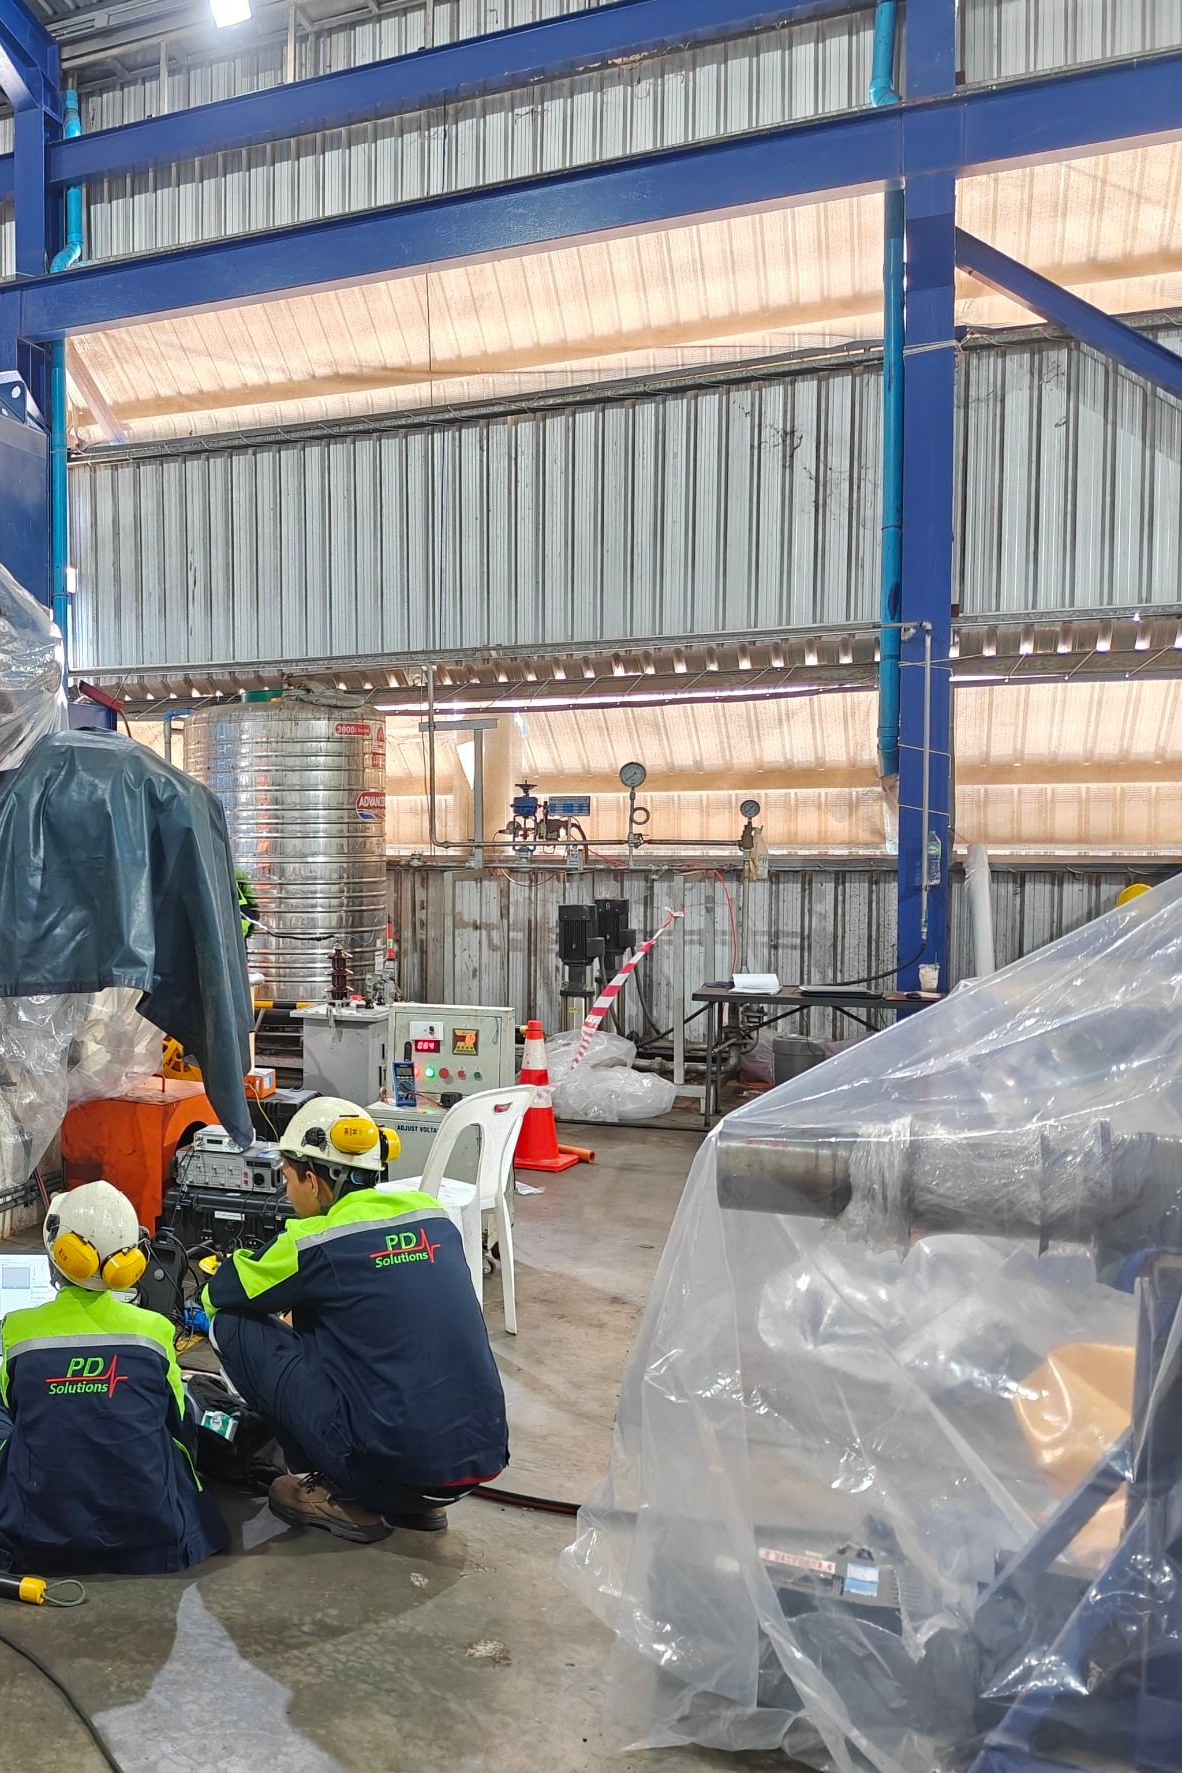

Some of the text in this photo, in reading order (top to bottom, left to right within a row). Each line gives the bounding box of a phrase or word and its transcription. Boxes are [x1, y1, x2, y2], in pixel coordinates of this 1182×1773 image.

[336, 725, 355, 735] 3000
[397, 1124, 440, 1134] ADJUST VOLTA
[385, 1232, 417, 1251] PD
[375, 1252, 429, 1268] Solutions
[66, 1357, 105, 1378] PD
[48, 1381, 109, 1395] Solutions
